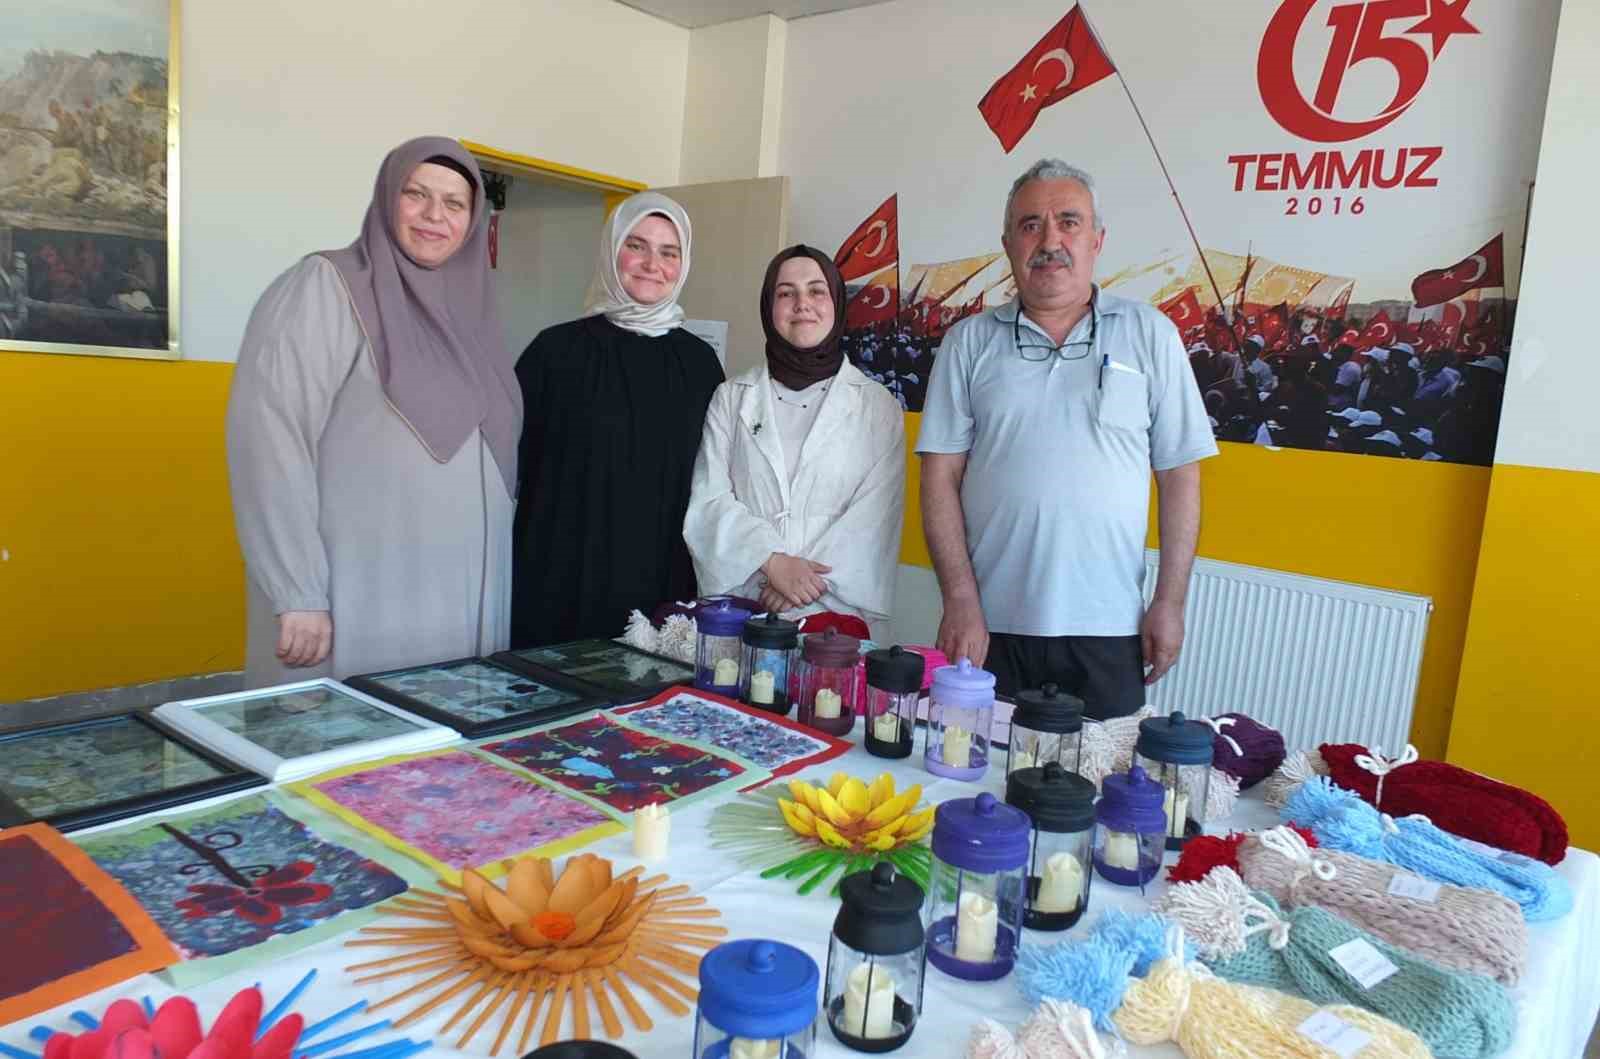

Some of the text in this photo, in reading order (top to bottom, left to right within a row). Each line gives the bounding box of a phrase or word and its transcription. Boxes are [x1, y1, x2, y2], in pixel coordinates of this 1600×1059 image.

[1313, 0, 1429, 117] 15
[1228, 146, 1443, 191] TEMMUZ
[1285, 197, 1365, 215] 2016
